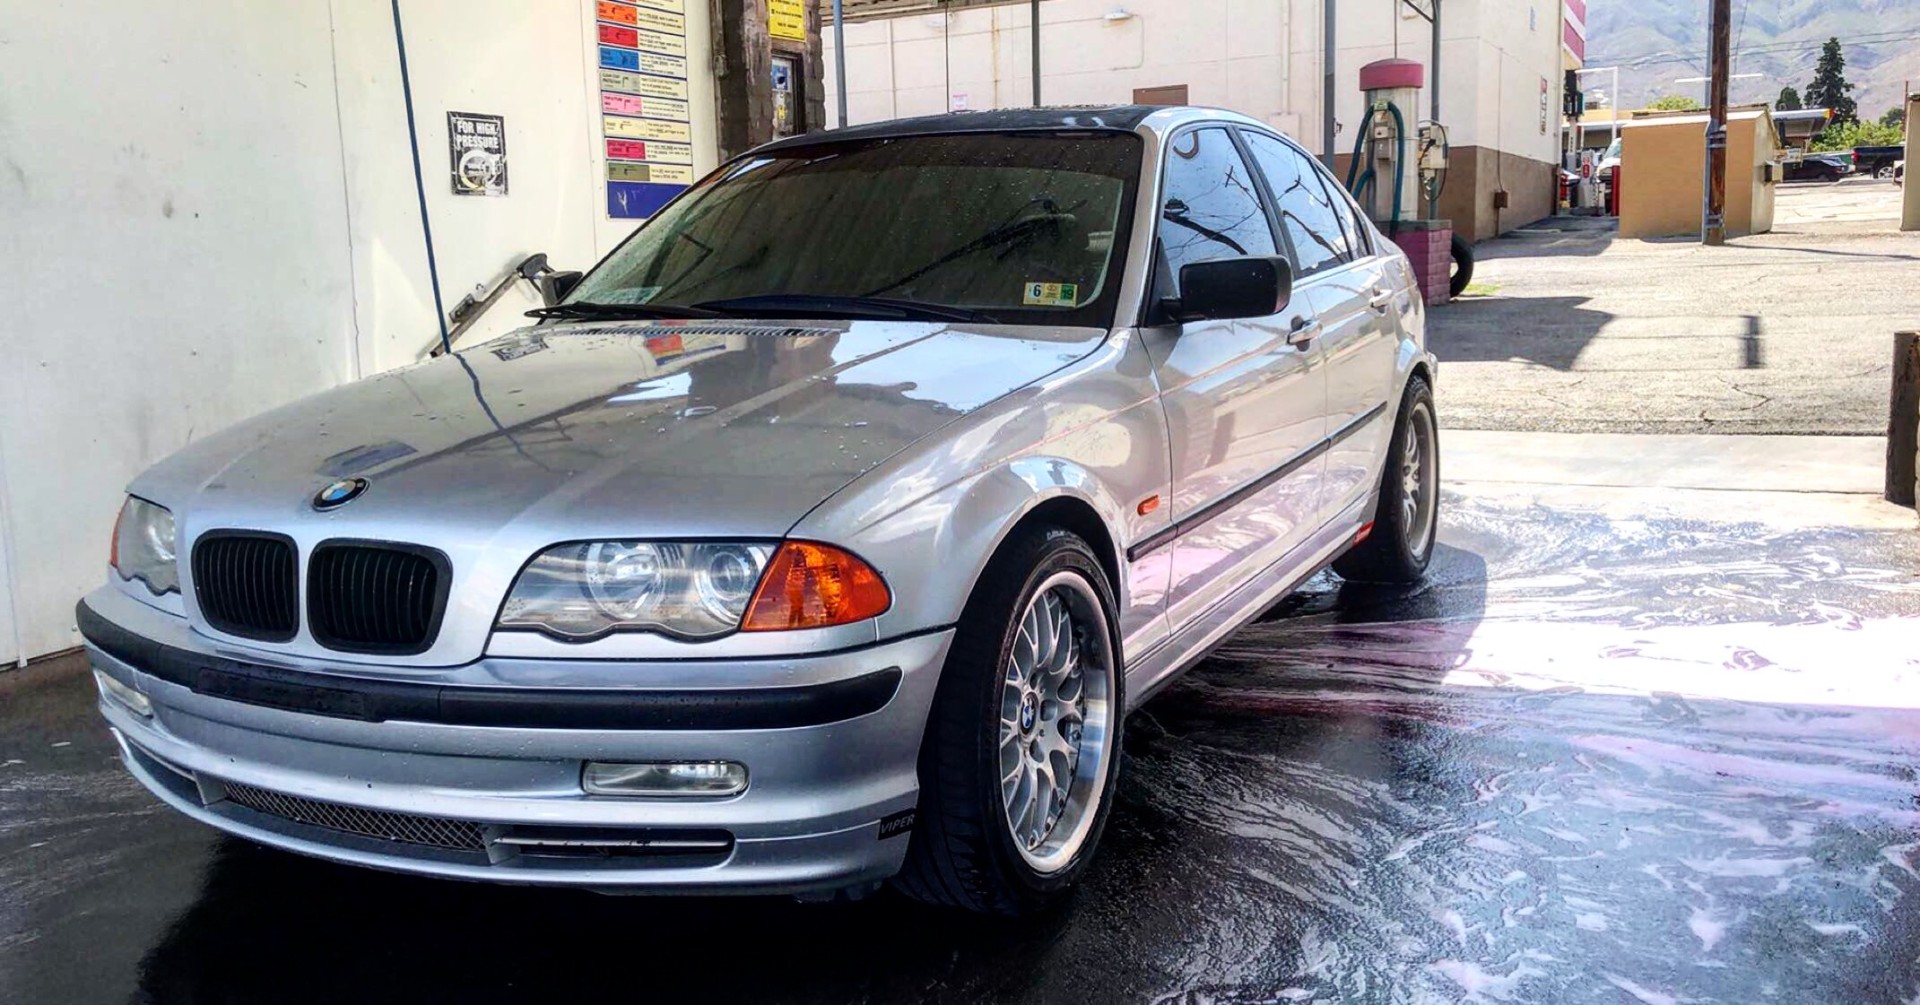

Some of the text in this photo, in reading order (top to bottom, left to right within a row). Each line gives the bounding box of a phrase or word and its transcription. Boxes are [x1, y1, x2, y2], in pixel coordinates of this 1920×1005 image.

[457, 121, 498, 135] FOR HIGH
[456, 135, 499, 149] PRESSURE
[1033, 284, 1041, 297] 6
[881, 814, 915, 833] VIPER
